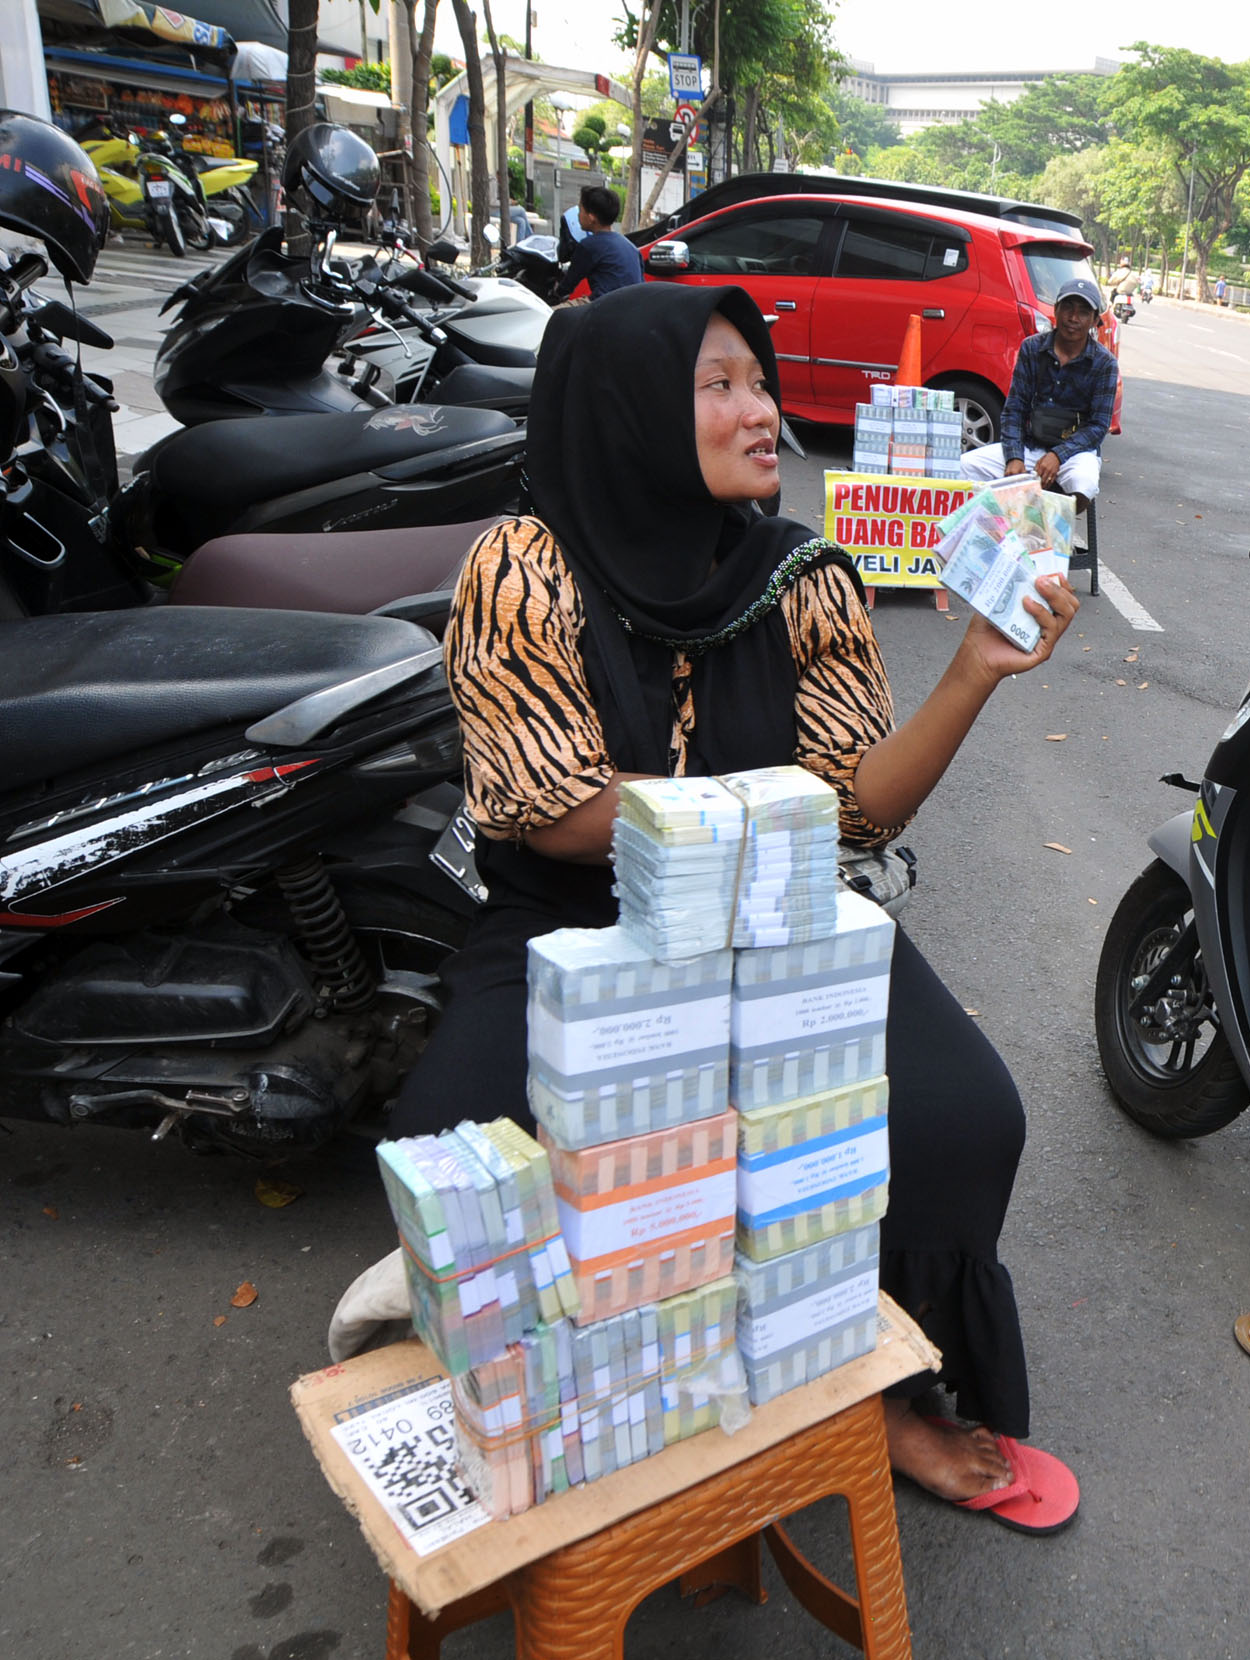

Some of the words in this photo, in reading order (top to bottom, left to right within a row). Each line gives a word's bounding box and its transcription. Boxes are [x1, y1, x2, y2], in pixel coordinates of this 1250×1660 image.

[674, 74, 698, 87] STOP
[861, 370, 891, 380] TRD
[834, 484, 975, 516] PENUKARA
[836, 517, 904, 547] UANG
[1010, 623, 1031, 643] 2000
[348, 1418, 413, 1455] 0412
